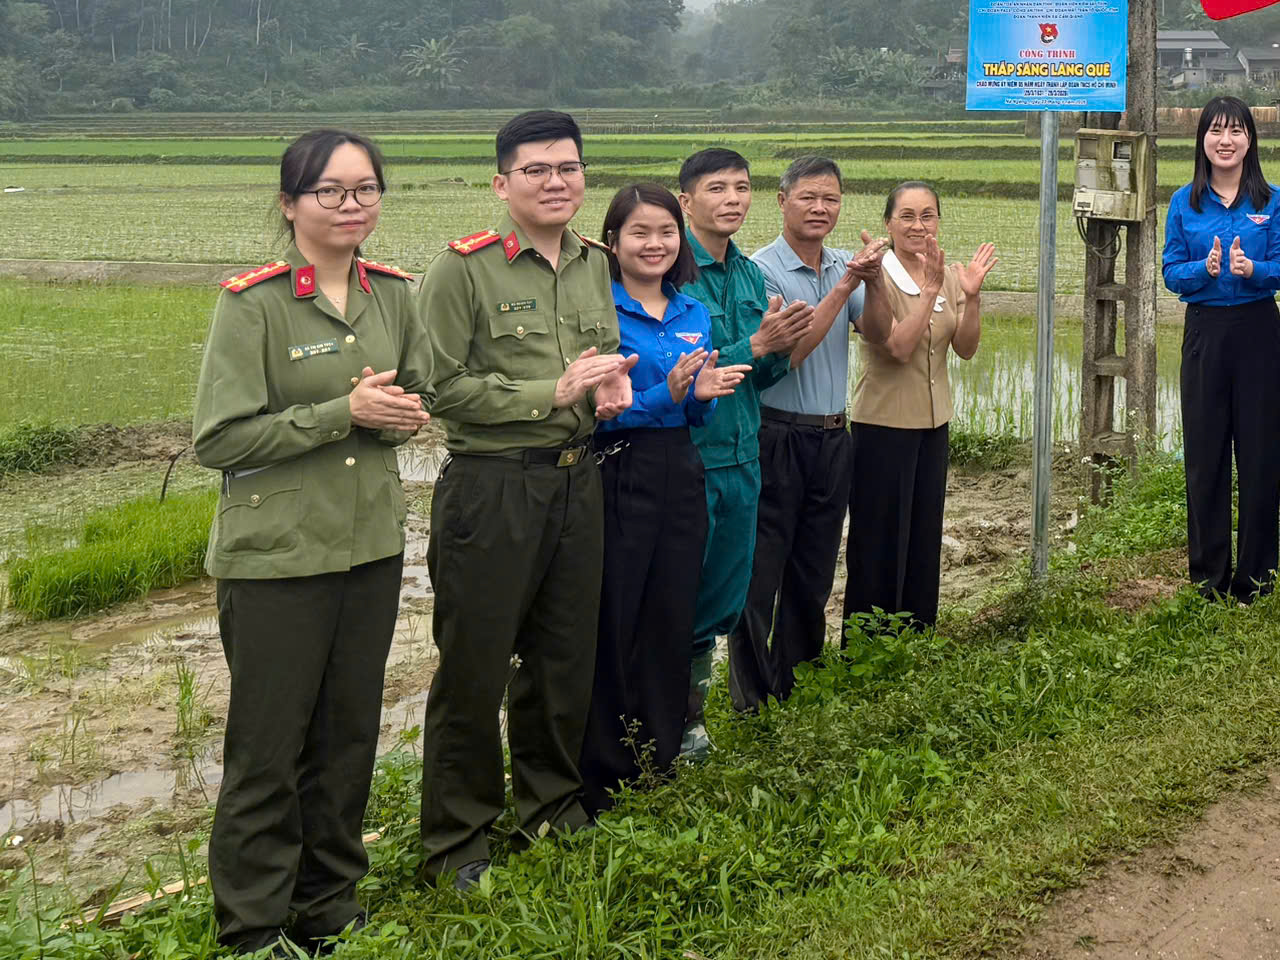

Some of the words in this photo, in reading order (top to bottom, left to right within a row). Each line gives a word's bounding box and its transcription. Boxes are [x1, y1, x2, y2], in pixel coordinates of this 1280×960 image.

[1019, 49, 1043, 58] CÔNG
[1016, 61, 1049, 77] SÁNG
[1050, 61, 1083, 77] LÀNG
[1085, 62, 1111, 78] QUÊ
